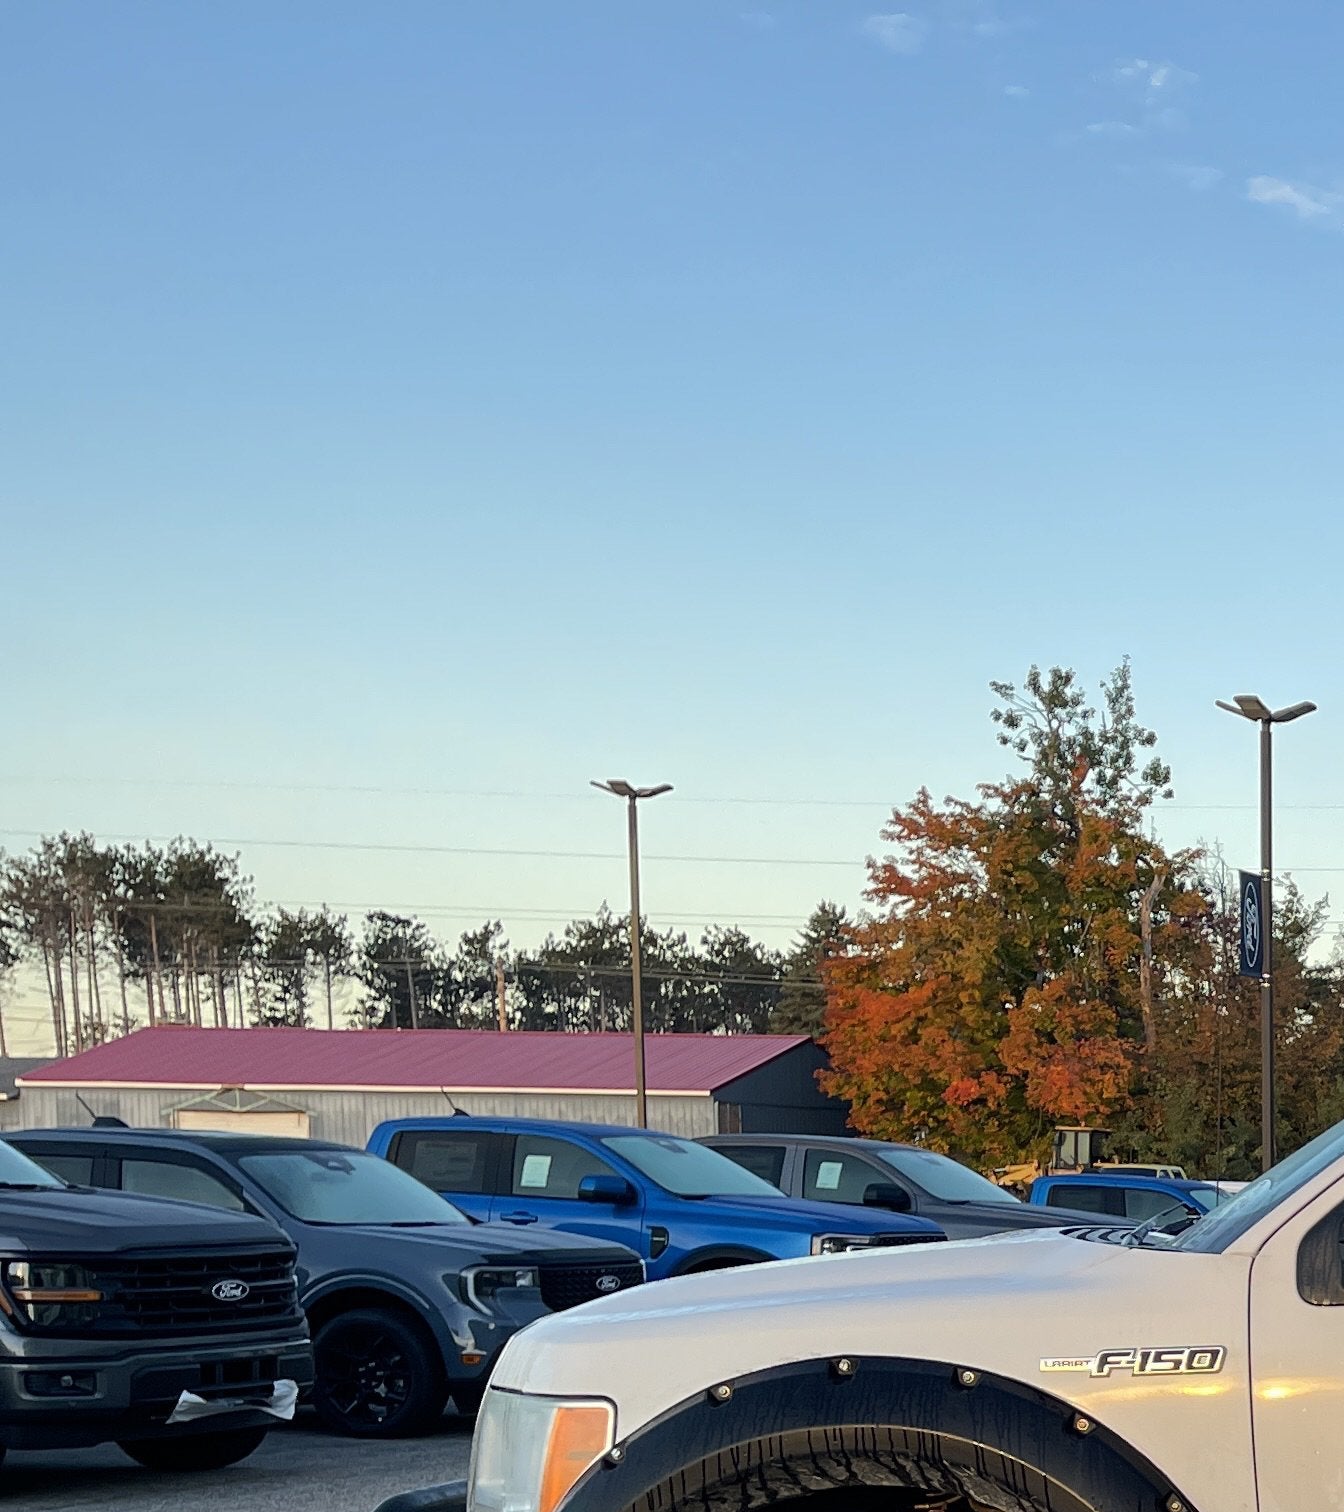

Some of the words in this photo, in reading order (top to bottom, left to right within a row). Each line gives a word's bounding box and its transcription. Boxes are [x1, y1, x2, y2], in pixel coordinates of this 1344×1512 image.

[1245, 896, 1258, 953] Ford
[218, 1282, 243, 1298] Ford
[600, 1276, 617, 1290] Ford
[1093, 1347, 1223, 1375] F-150
